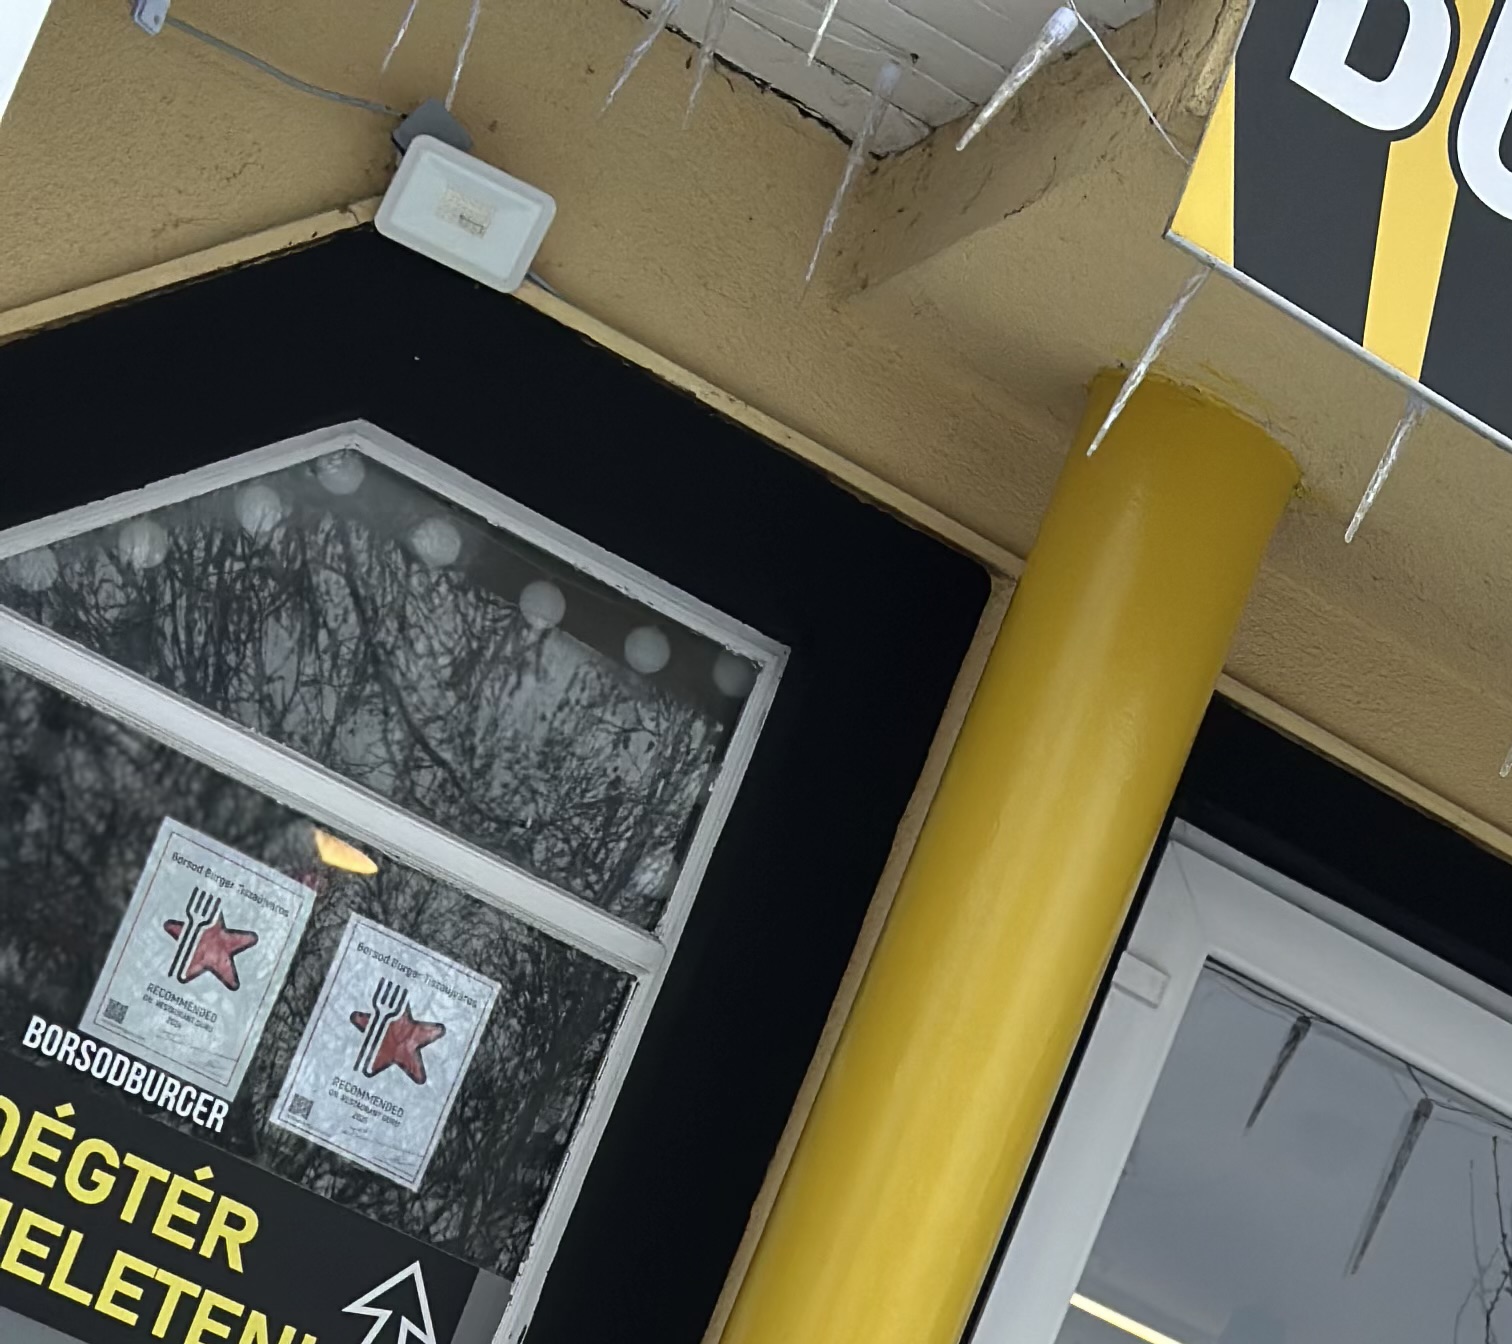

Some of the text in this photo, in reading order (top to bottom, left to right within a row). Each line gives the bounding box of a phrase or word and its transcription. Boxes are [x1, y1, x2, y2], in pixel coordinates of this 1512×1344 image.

[146, 982, 218, 1024] RECOMMENDED
[22, 1015, 230, 1134] BORSODBURGER
[331, 1076, 405, 1118] RECOMMENDED
